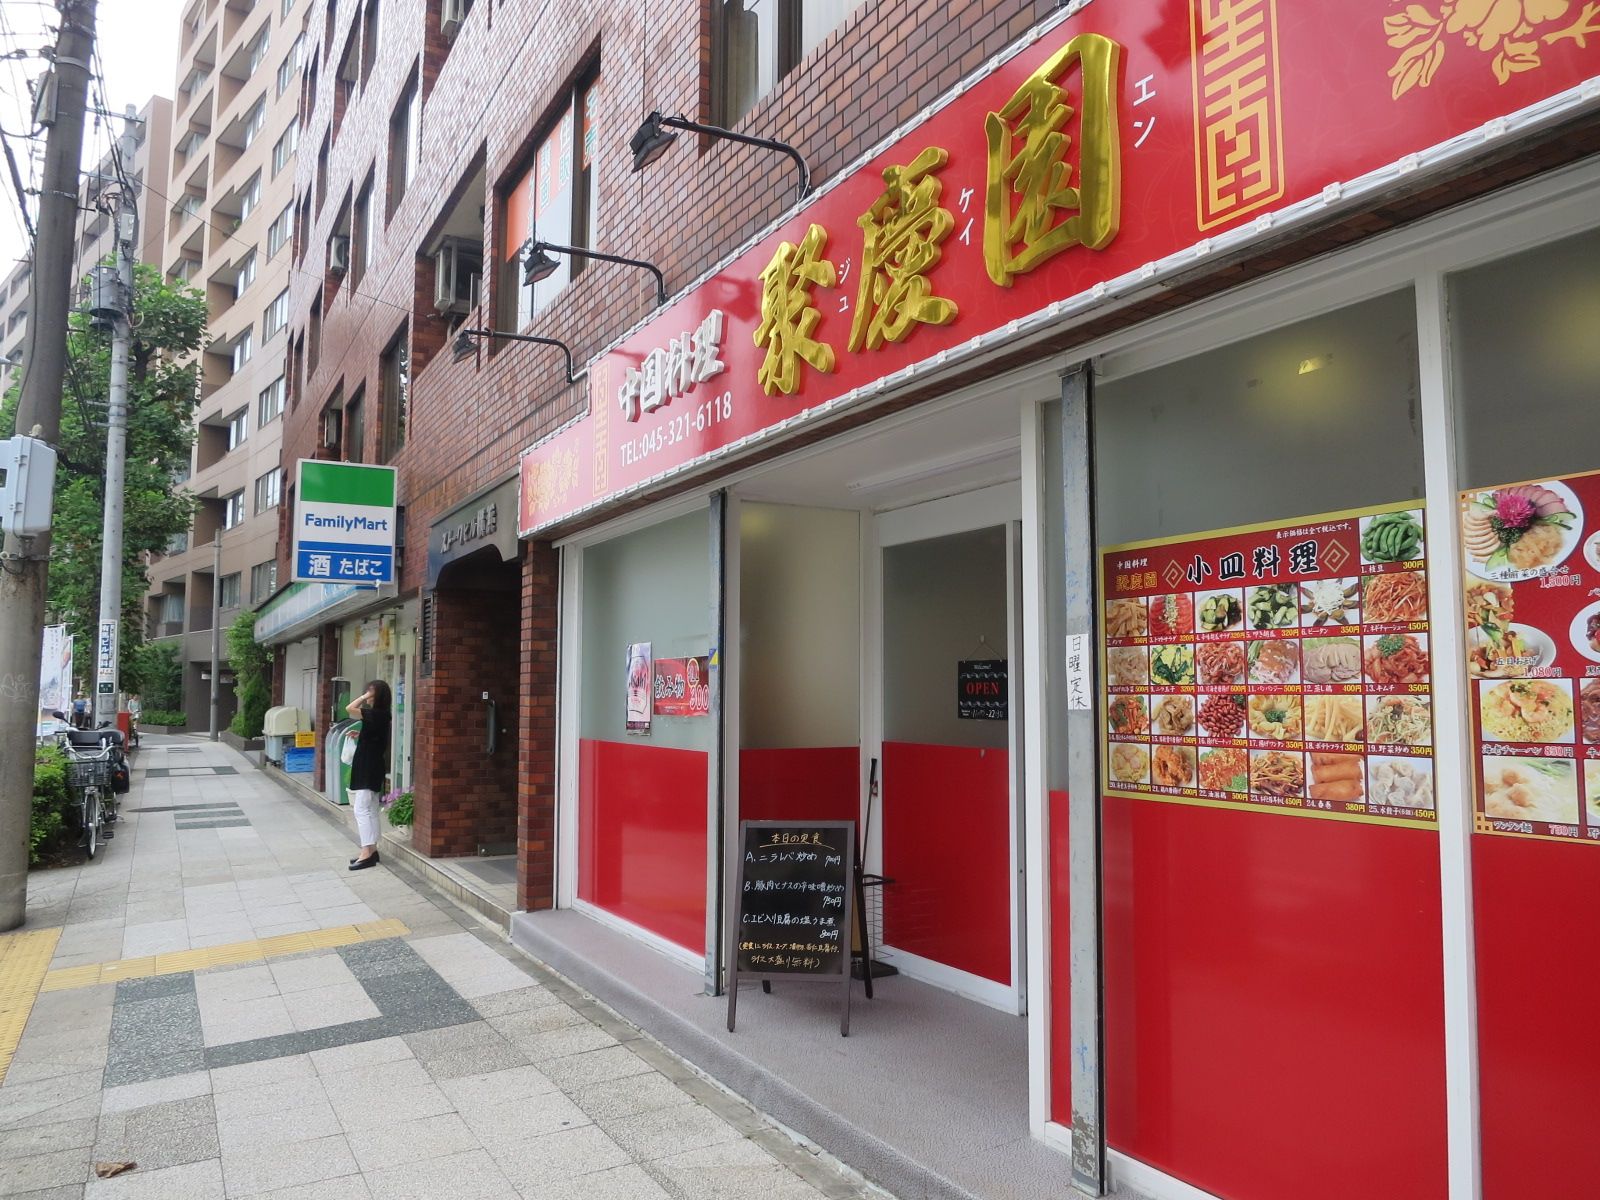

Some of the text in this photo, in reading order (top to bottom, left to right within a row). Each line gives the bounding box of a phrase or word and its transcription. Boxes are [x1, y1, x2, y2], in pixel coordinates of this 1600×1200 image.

[1132, 73, 1157, 149] エン
[753, 32, 1121, 397] 聚慶園
[957, 185, 976, 247] ケイ
[836, 257, 852, 314] ジュ
[618, 308, 725, 423] 中国料理
[620, 390, 733, 468] TEL:045-321-6118
[304, 513, 389, 533] FamilyMart
[308, 553, 384, 577] 酒 たばこ
[1116, 558, 1149, 570] 中国料理
[1186, 539, 1320, 586] 小皿料理
[1402, 561, 1425, 570] 300円
[1067, 635, 1087, 710] 日曜定休
[654, 674, 685, 699] 飲み物
[966, 681, 999, 696] OPEN
[1408, 684, 1430, 693] 350円
[1410, 747, 1433, 756] 350円
[771, 832, 823, 845] 本日の定食
